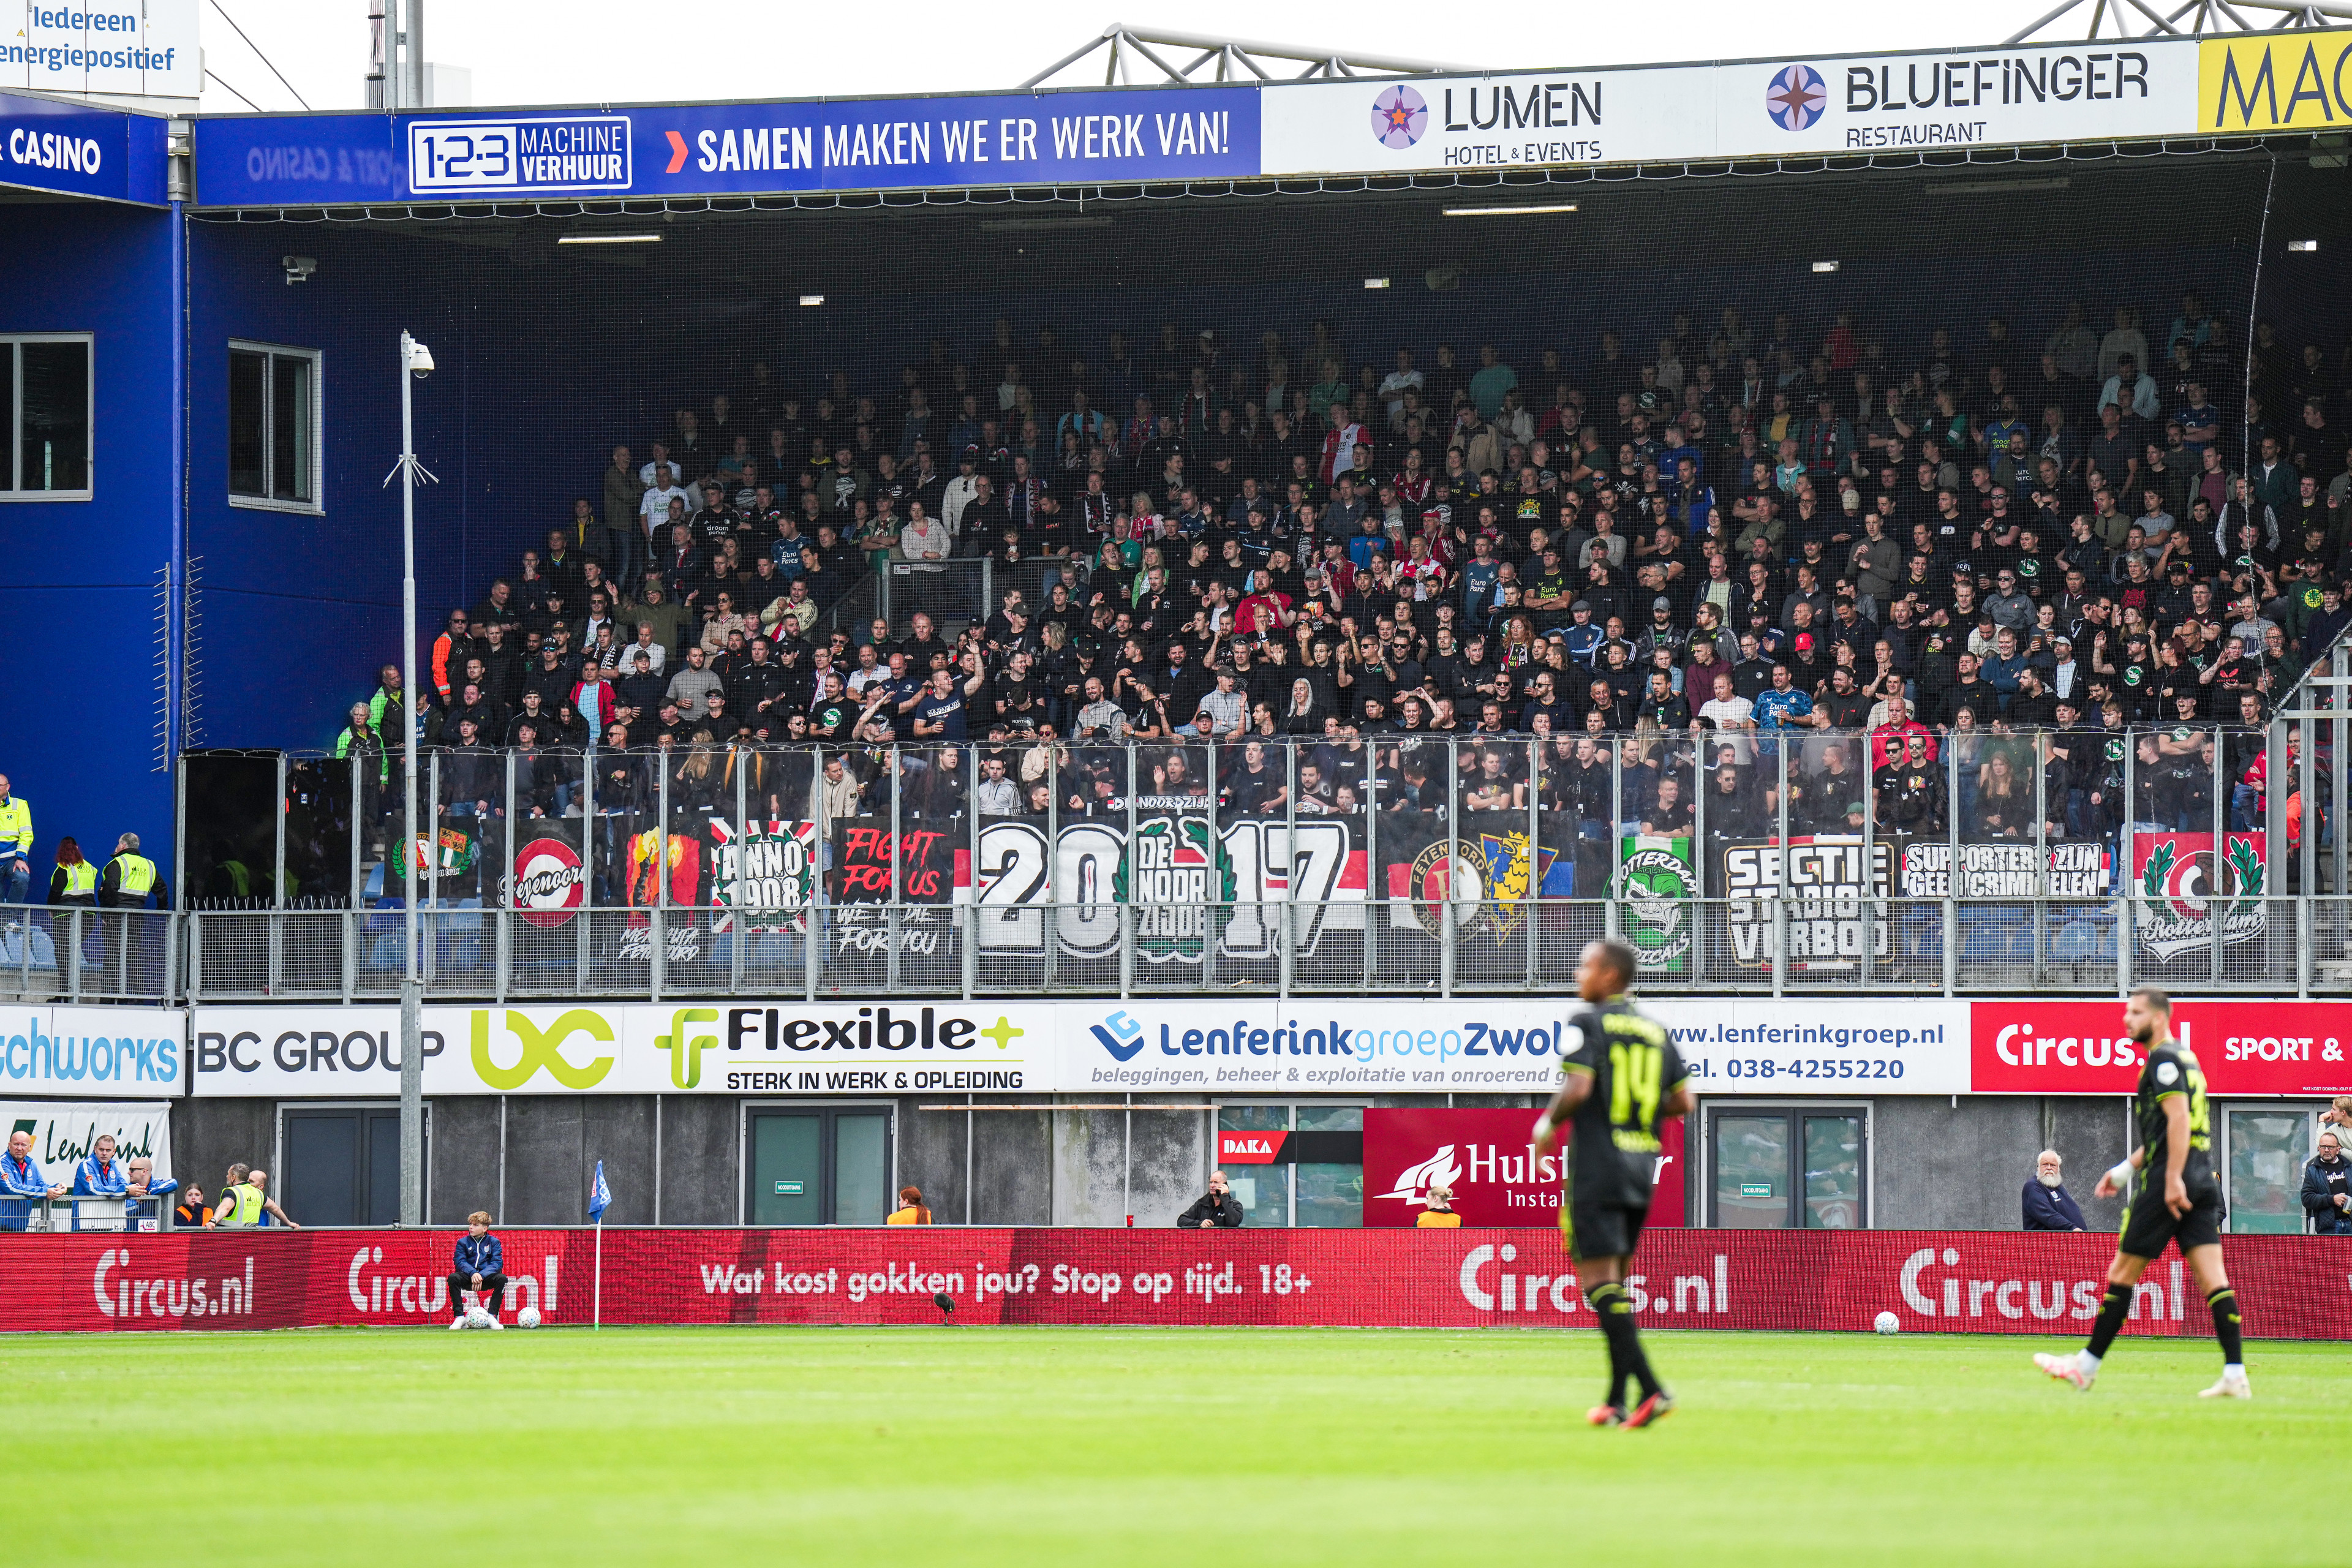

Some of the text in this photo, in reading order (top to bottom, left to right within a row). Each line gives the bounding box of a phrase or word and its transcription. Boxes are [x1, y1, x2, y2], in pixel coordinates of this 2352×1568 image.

[34, 6, 135, 32] Iedereen
[0, 43, 175, 72] energiepositief
[1847, 51, 2148, 113] BLUEFINGER
[1445, 81, 1601, 132] LUMEN
[9, 128, 101, 175] CASINO
[521, 126, 622, 154] MACHINE
[698, 111, 1229, 173] SAMEN MAKEN WE ER WERK VAN!
[1445, 140, 1602, 165] HOTEL & EVENTS
[1847, 121, 1987, 148] RESTAURANT
[521, 156, 624, 183] VERHUUR
[722, 840, 803, 881] ANNO
[844, 828, 948, 867] FIGHT
[1138, 836, 1171, 869] DE
[1413, 843, 1485, 884] FEYENORD
[2056, 844, 2101, 872] ZIJN
[908, 870, 940, 896] US
[1728, 846, 1887, 886] SECTIE
[1970, 871, 2099, 897] CRIMIELEN
[722, 876, 801, 916] 1908
[1730, 886, 1887, 922] STADION
[197, 1030, 445, 1073] BC GROUP
[1159, 1020, 1572, 1063] LenferinkgroepZwol
[1664, 1023, 1943, 1049] ww.lenferinkgroep.nl
[1996, 1022, 2190, 1067] Circus.l
[2225, 1037, 2313, 1061] SPORT
[2321, 1037, 2345, 1061] &
[727, 1071, 1023, 1090] STERK IN WERK & OPLEIDING
[1091, 1067, 1210, 1086] beleggingen,
[1216, 1067, 1281, 1082] beheer
[1286, 1068, 1300, 1082] &
[1305, 1067, 1406, 1085] exploitatie
[1412, 1071, 1446, 1082] van
[1450, 1067, 1550, 1082] onroerend
[1609, 1041, 1662, 1131] 14
[1726, 1058, 1904, 1079] 038-4255220
[45, 1119, 153, 1165] Lenfink
[1224, 1139, 1273, 1153] DAKA
[1506, 1189, 1566, 1207] Instal
[94, 1248, 254, 1317] Circus.nl
[700, 1262, 1312, 1303] Wat kost gokken jou? Stop op tijd. 18+
[1899, 1246, 2185, 1321] Circusnl
